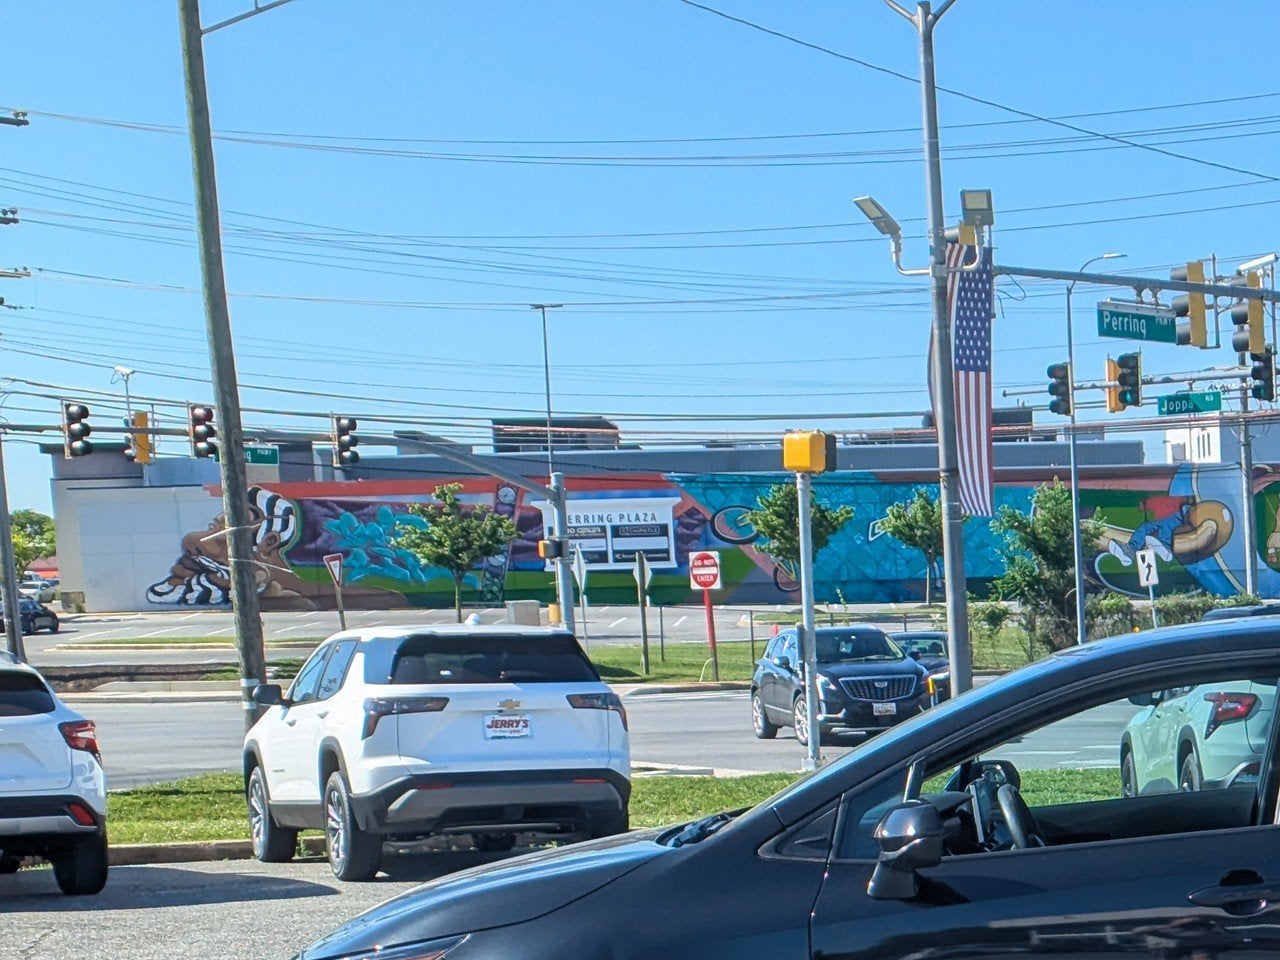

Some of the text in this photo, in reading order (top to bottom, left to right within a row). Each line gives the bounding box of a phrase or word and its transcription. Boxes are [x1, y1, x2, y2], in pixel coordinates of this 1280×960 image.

[1102, 310, 1147, 338] Perring
[1161, 400, 1194, 412] Joppa
[567, 512, 658, 524] ERRING PLAZA
[486, 719, 529, 729] JERRY'S
